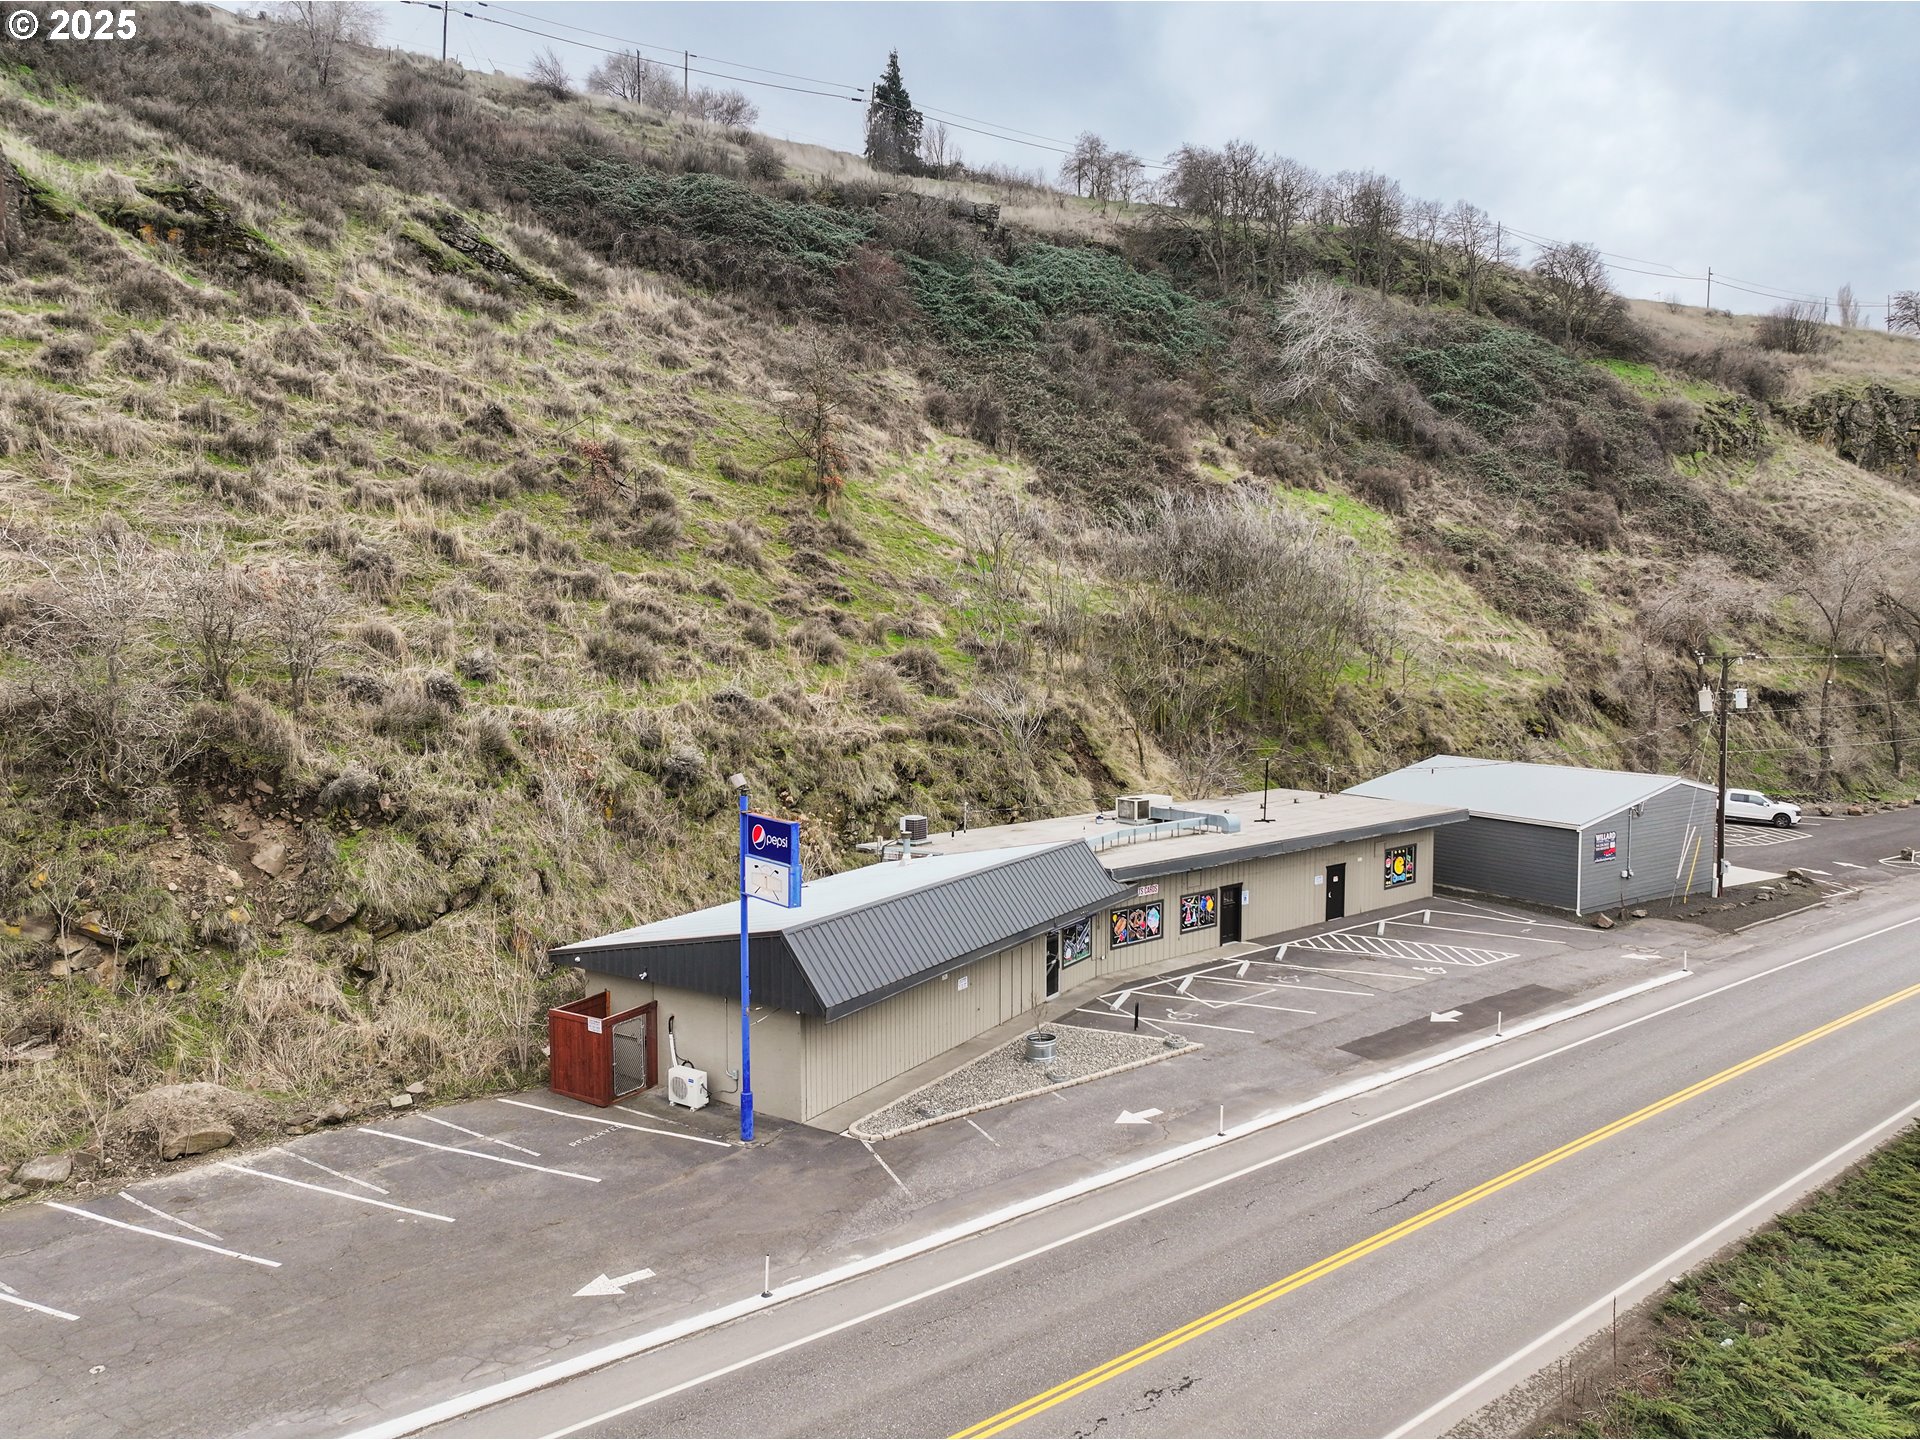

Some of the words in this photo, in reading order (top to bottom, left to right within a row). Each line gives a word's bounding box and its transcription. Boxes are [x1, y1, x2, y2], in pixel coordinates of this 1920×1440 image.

[766, 834, 788, 848] pepsi
[1596, 831, 1616, 841] WILLARD
[568, 1124, 624, 1147] RESERVED
